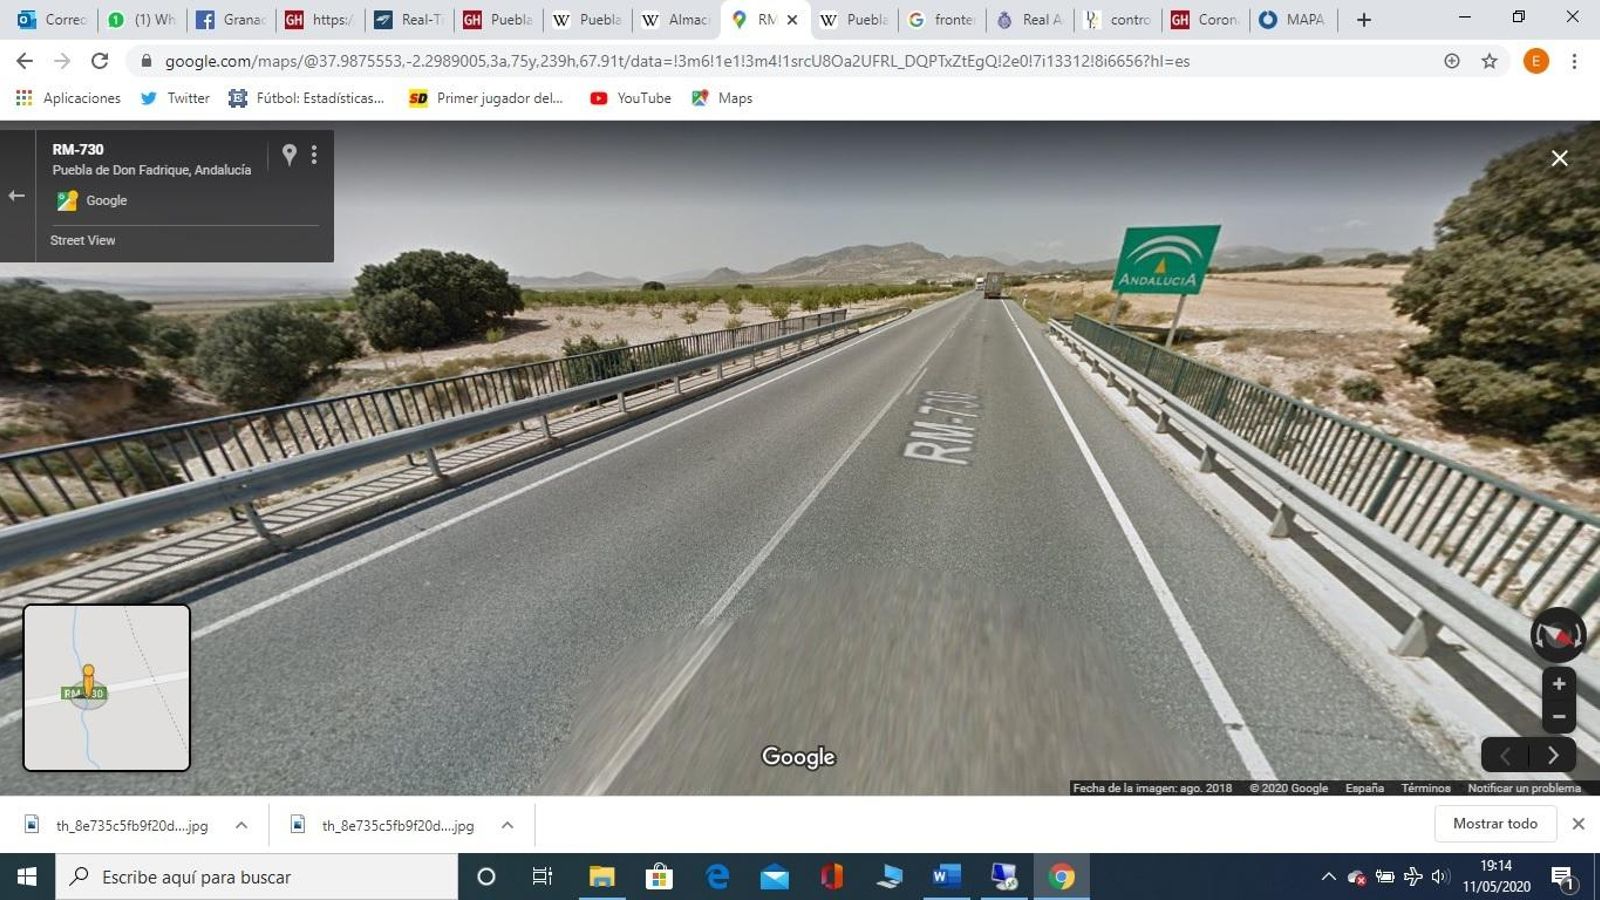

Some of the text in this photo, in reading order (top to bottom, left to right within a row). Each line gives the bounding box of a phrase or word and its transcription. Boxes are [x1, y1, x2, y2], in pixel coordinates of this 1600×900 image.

[135, 12, 151, 27] (1)
[286, 14, 304, 26] GH
[464, 14, 482, 26] GH
[1024, 13, 1049, 26] Real
[1110, 15, 1151, 27] contro
[1172, 14, 1190, 26] GH
[1288, 13, 1325, 26] MAPA
[1533, 56, 1539, 66] E
[43, 92, 121, 107] Aplicaciones
[168, 92, 210, 103] Twitter
[257, 92, 384, 103] Fútbol: Estadísticas...
[409, 93, 428, 104] SD
[438, 92, 563, 107] Primer jugador del...
[618, 92, 672, 103] YouTube
[719, 92, 753, 107] Maps
[53, 144, 104, 155] RM-730
[53, 164, 251, 177] Puebla de Don Fadrique, Andalucía
[87, 195, 127, 208] Google
[51, 235, 115, 245] Street View
[1454, 817, 1538, 829] Mostrar todo
[1481, 860, 1512, 871] 19:14
[103, 870, 292, 887] Escribe aquí para buscar
[1464, 881, 1531, 893] 11/05/2020
